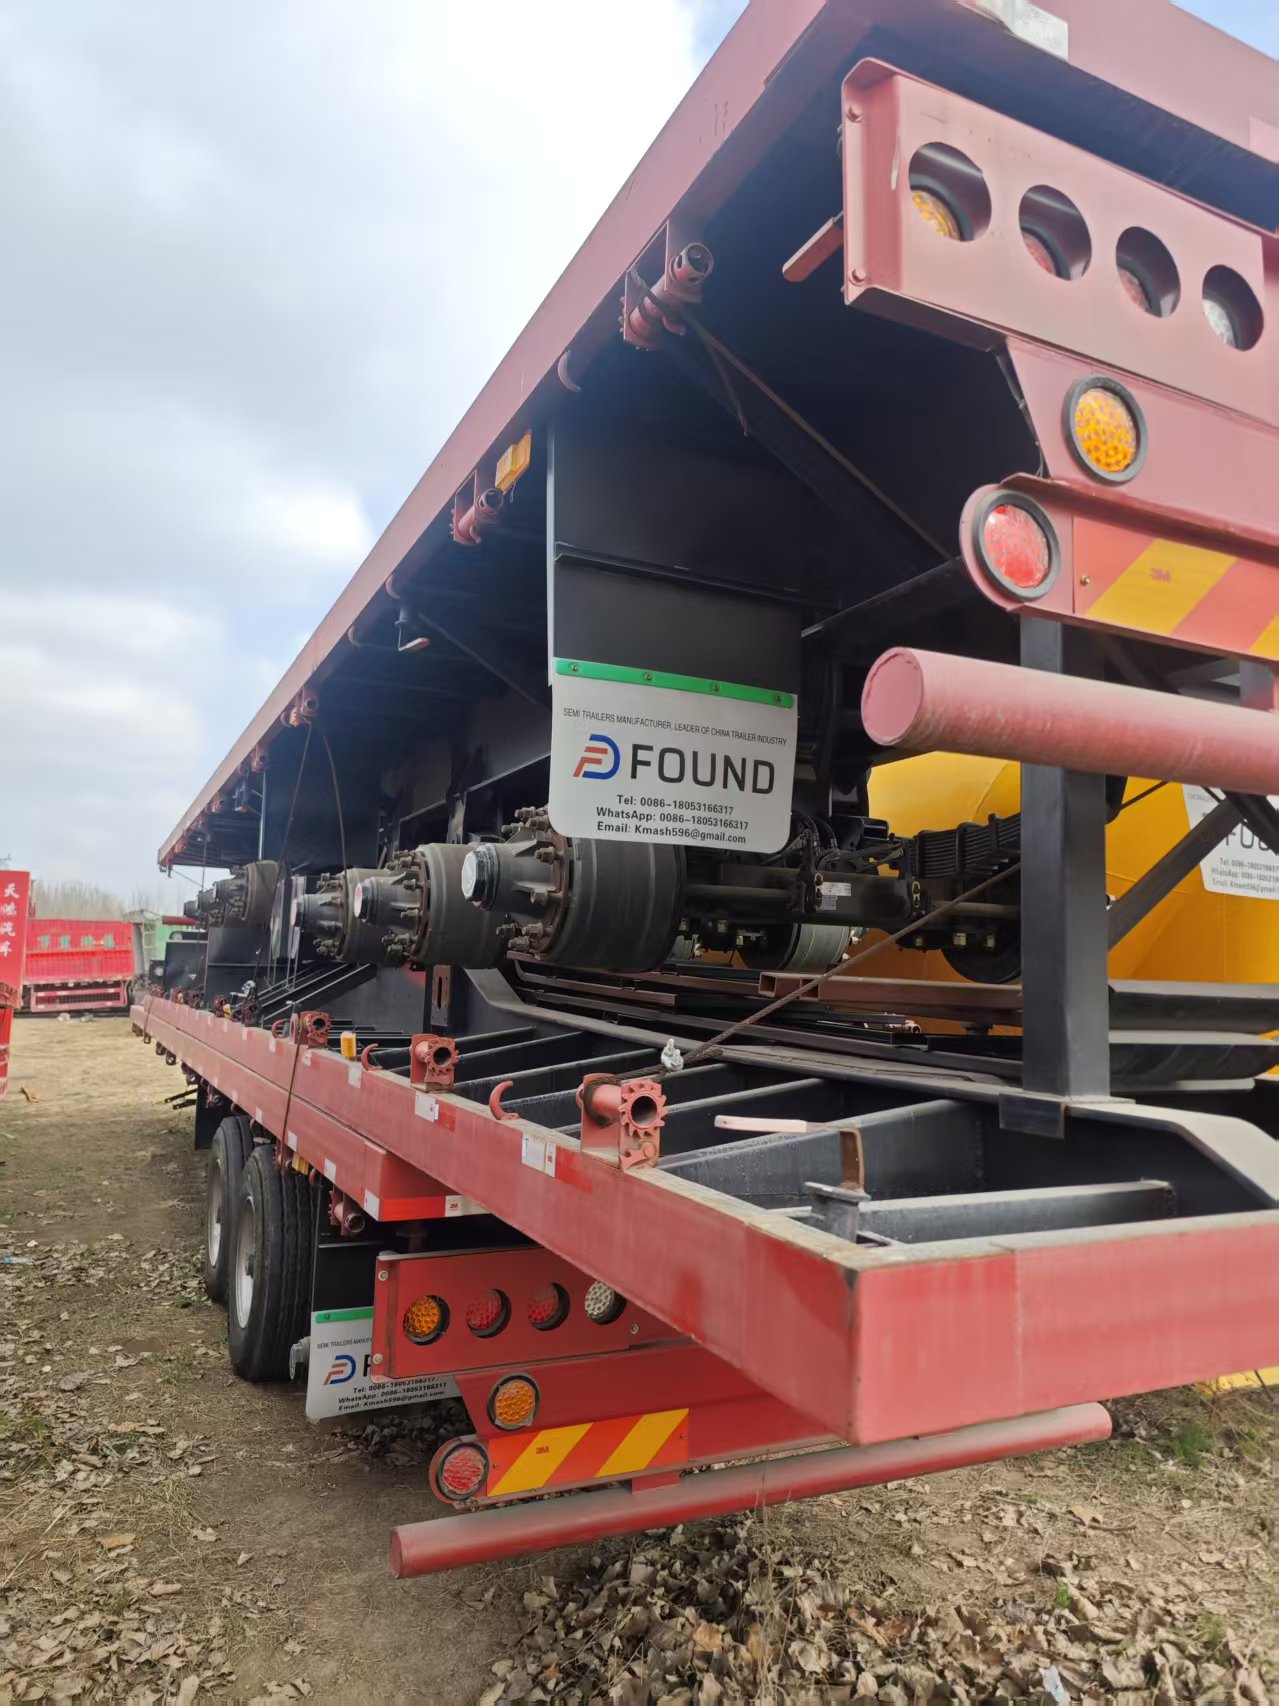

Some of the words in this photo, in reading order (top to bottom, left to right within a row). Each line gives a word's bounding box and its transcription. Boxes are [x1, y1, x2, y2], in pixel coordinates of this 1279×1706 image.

[563, 708, 580, 718] SEMI
[582, 710, 615, 723] TRAILERS
[675, 722, 700, 734] LEADER
[701, 726, 710, 735] OF
[711, 727, 730, 738] CHINA
[731, 730, 756, 742] TRAILER
[757, 732, 788, 746] INDUSTRY
[630, 743, 775, 795] FOUND
[617, 794, 636, 806] Tel:
[596, 806, 656, 822] WhatsApp:
[597, 821, 631, 833] Email:
[634, 824, 746, 844] Kmash596@gmail.com
[330, 1338, 353, 1347] TRAILERS
[353, 1386, 367, 1394] Tel:
[338, 1392, 379, 1404] WhatsApp:
[536, 1446, 549, 1455] 3M
